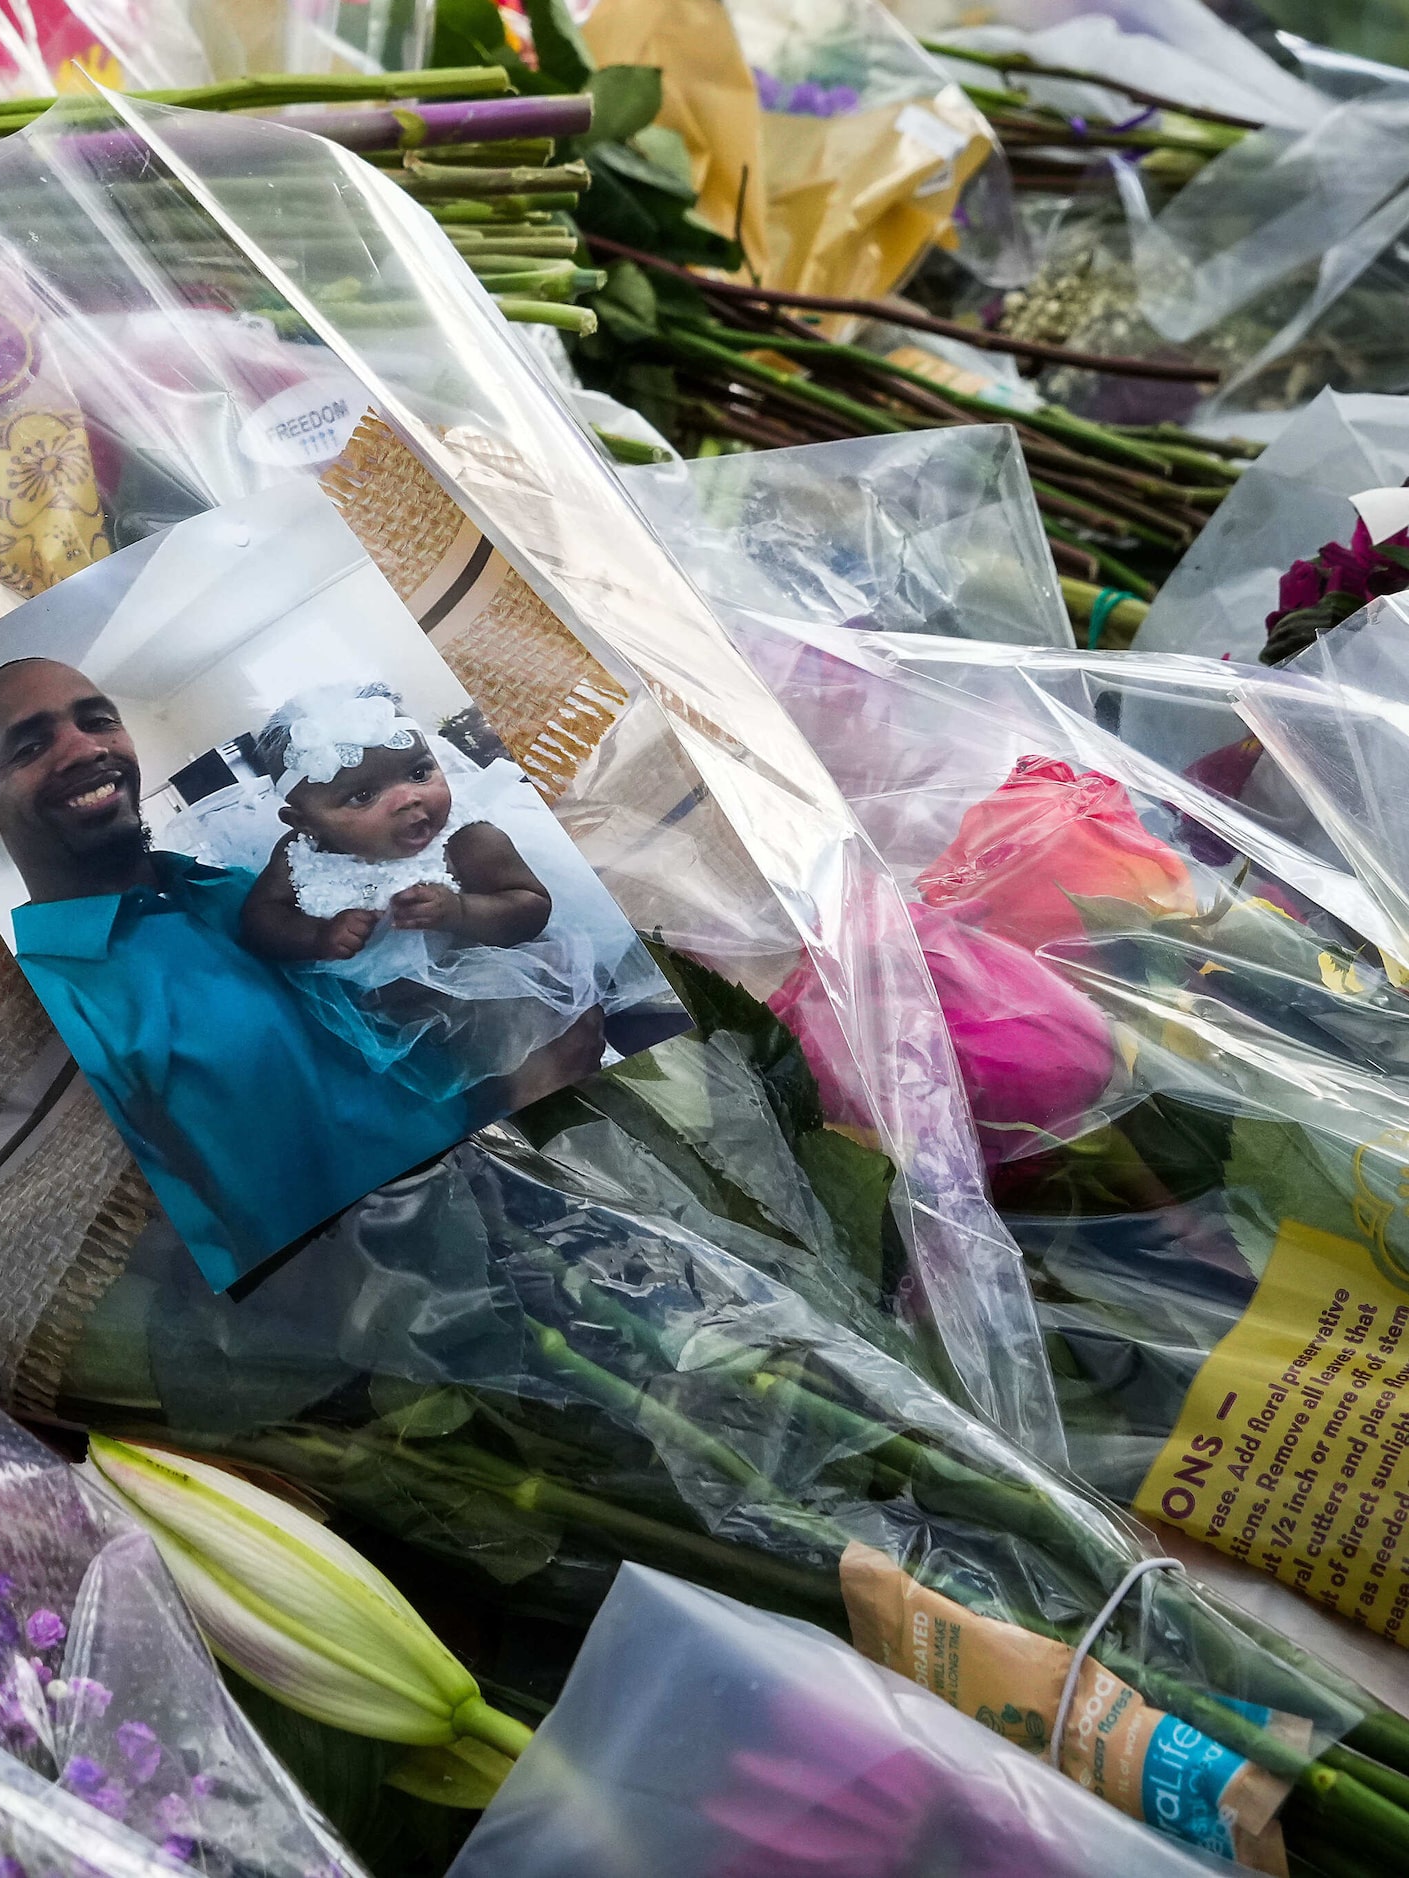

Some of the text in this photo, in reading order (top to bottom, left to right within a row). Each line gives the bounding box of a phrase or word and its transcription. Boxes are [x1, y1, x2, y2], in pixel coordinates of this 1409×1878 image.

[1343, 1303, 1378, 1345] that
[1309, 1347, 1357, 1387] leaves
[1351, 1367, 1374, 1389] off
[1366, 1353, 1386, 1371] of
[1205, 1288, 1350, 1538] vase. Add floral preservative
[1300, 1385, 1325, 1410] all
[1323, 1391, 1359, 1438] more
[1256, 1412, 1310, 1492] Remove
[1307, 1481, 1348, 1557] cutters
[1340, 1436, 1369, 1479] and
[1359, 1390, 1396, 1439] place
[1311, 1440, 1330, 1464] or
[1161, 1434, 1223, 1520] ONS
[1282, 1466, 1319, 1515] inch
[1270, 1516, 1297, 1549] 1/2
[1337, 1491, 1380, 1559] direct
[1359, 1581, 1379, 1606] as
[1369, 1490, 1409, 1578] needed
[1328, 1558, 1349, 1587] of
[934, 1616, 946, 1658] MAKE
[1098, 1688, 1133, 1734] flores
